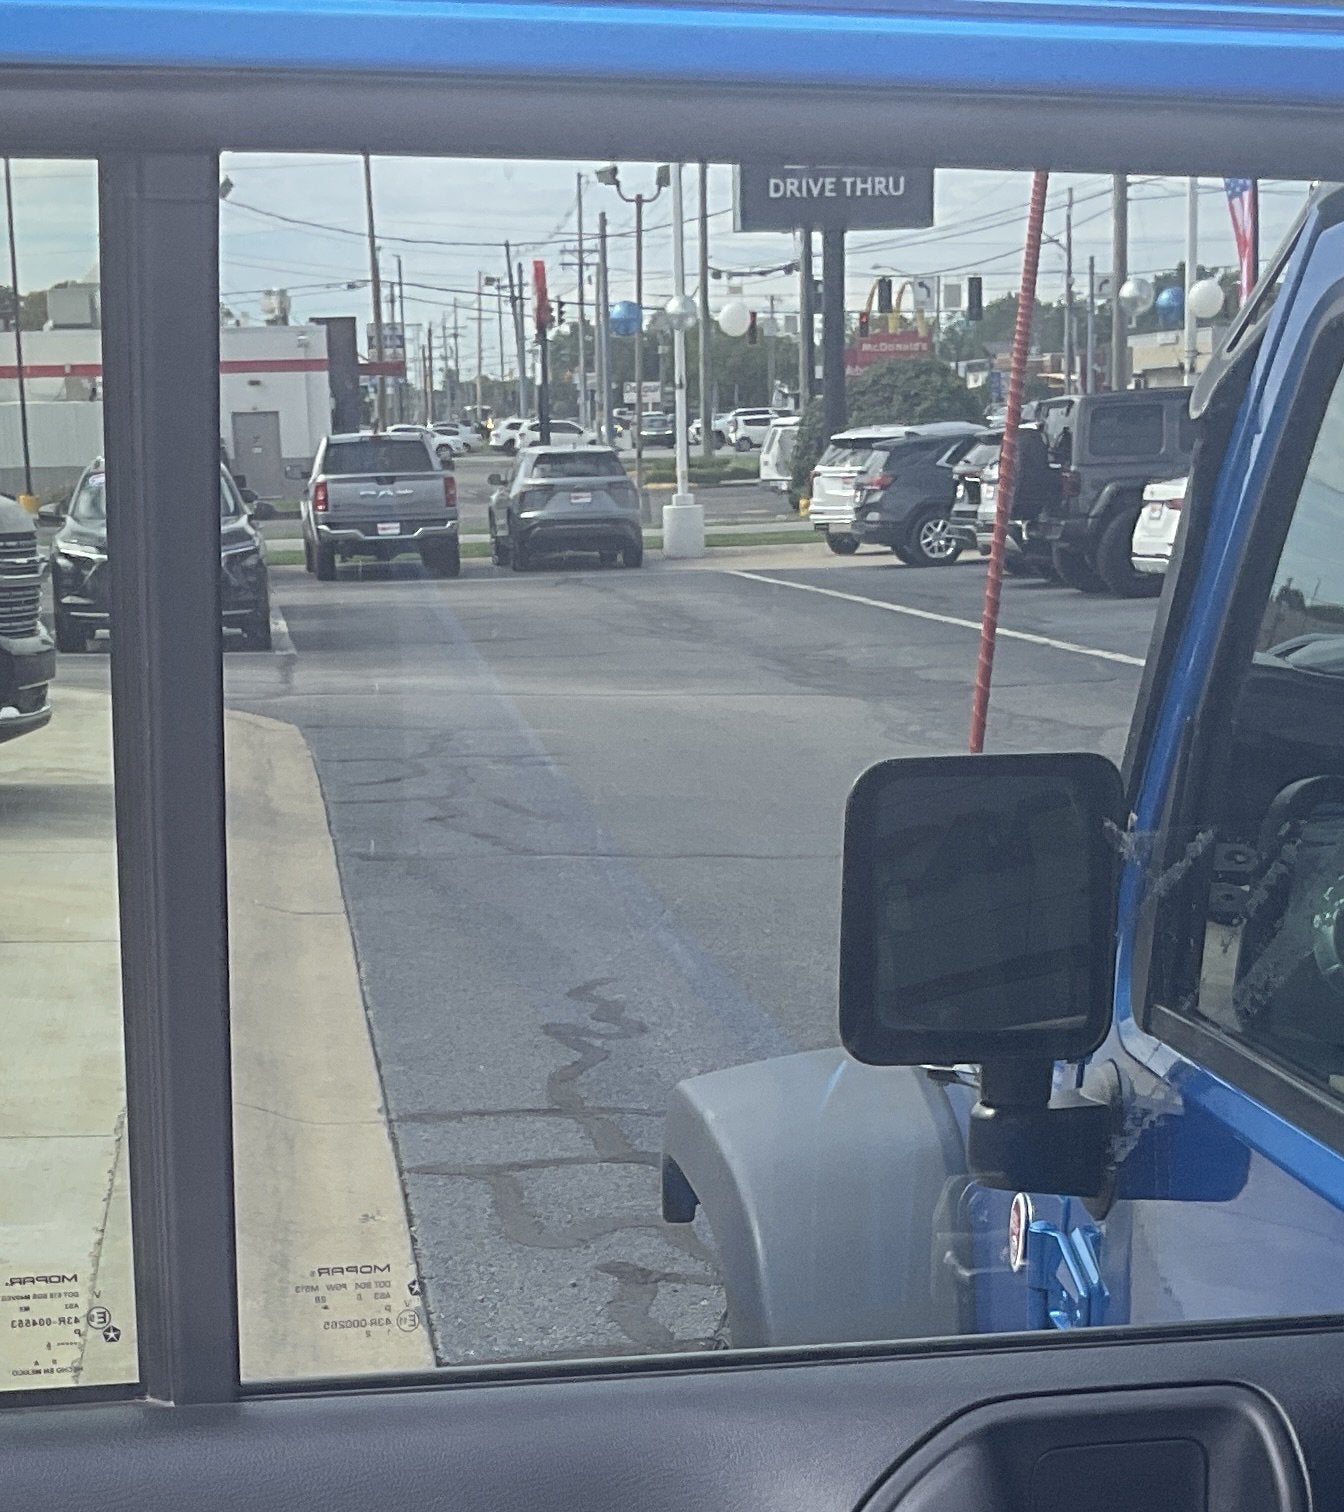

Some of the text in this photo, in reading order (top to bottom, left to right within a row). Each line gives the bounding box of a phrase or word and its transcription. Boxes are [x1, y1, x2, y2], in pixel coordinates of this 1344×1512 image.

[768, 175, 905, 198] DRIVE THRU
[862, 342, 928, 352] McDonald's
